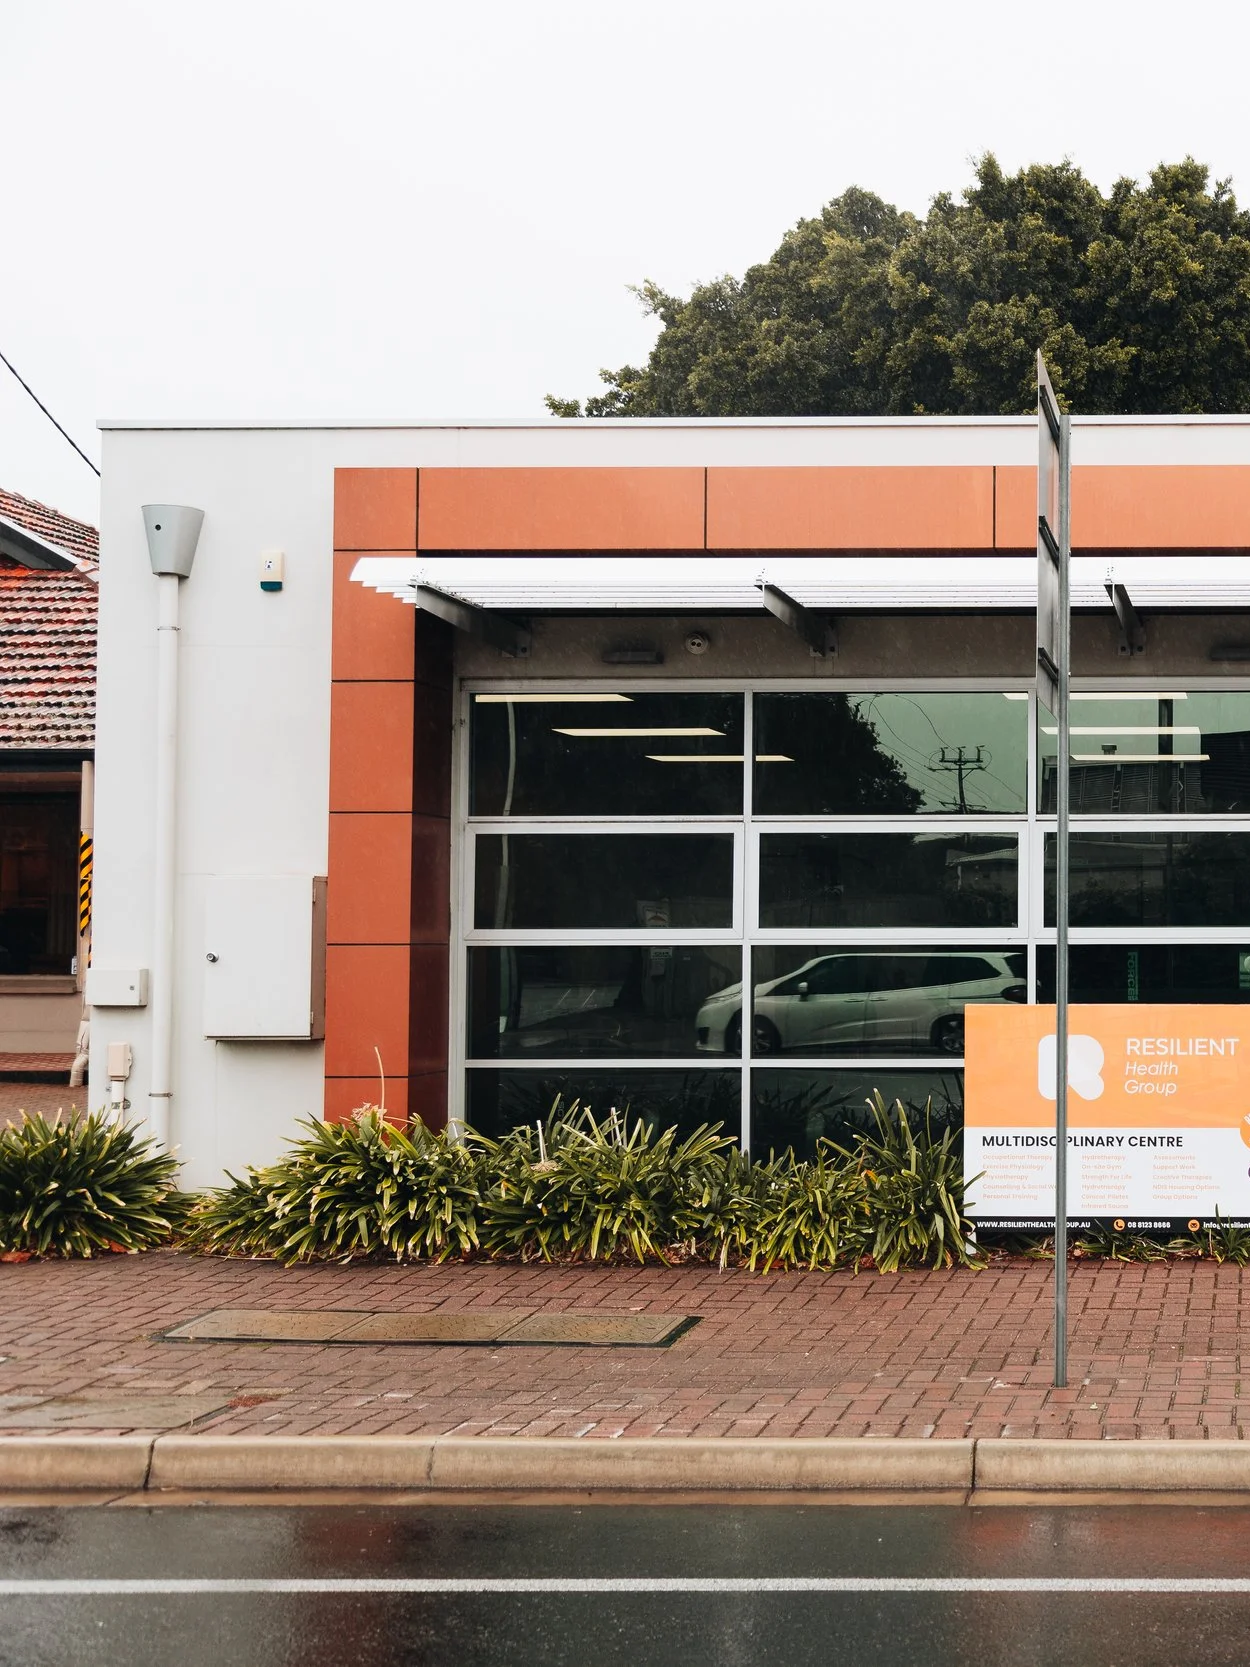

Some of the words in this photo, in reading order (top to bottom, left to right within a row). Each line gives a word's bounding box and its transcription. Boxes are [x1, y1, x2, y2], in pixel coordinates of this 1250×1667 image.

[1126, 1038, 1240, 1056] RESILIENT
[1125, 1061, 1179, 1076] Health
[1124, 1079, 1177, 1097] Group
[982, 1136, 1124, 1147] MULTIDISCPLINARY
[1128, 1136, 1183, 1147] CENTRE
[1009, 1163, 1044, 1171] Physiology
